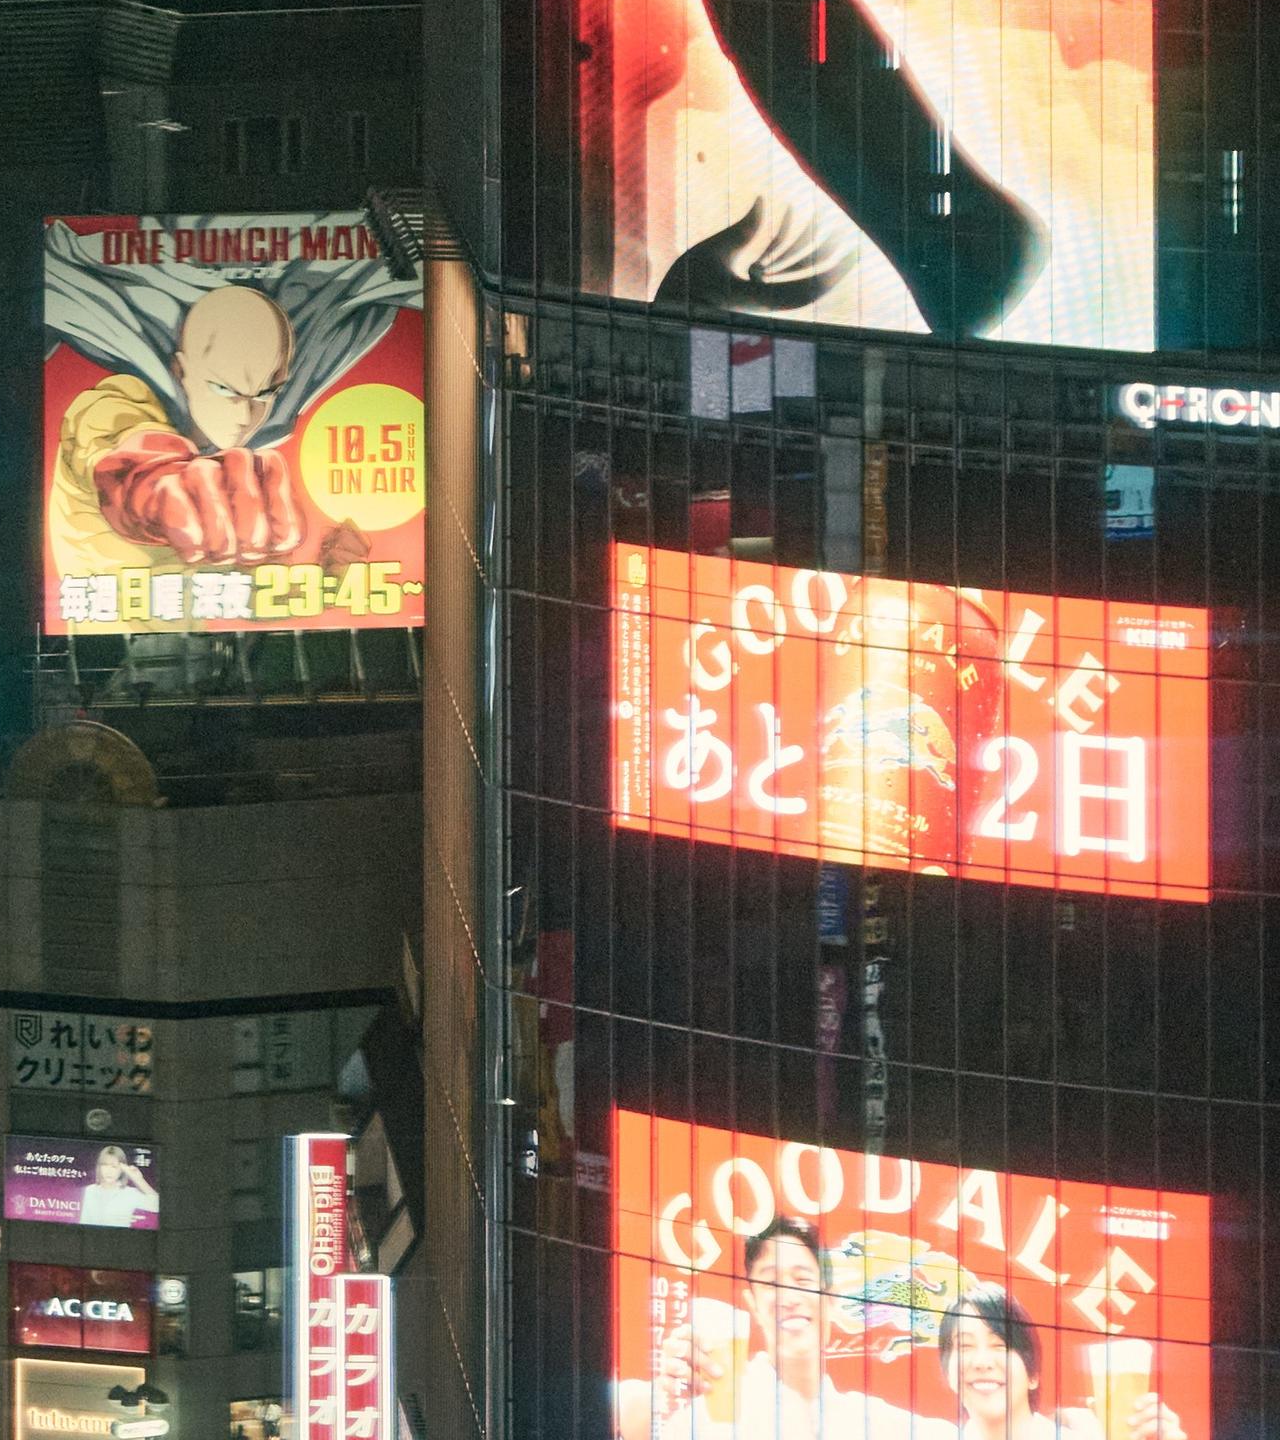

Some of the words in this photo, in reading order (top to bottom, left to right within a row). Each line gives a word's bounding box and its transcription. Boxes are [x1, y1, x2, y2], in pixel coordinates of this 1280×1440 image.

[102, 227, 165, 266] ONE
[175, 226, 289, 263] PUNCH
[300, 225, 380, 261] MAN
[327, 425, 403, 465] 10.5
[330, 469, 362, 495] ON
[372, 466, 417, 494] AIR
[664, 696, 808, 815] あと
[977, 731, 1146, 862] 2日
[50, 1019, 153, 1054] れいわ
[16, 1056, 153, 1091] クリニック
[48, 1197, 81, 1212] VINCI
[659, 1142, 921, 1276] GOOD
[941, 1169, 1156, 1336] ALE
